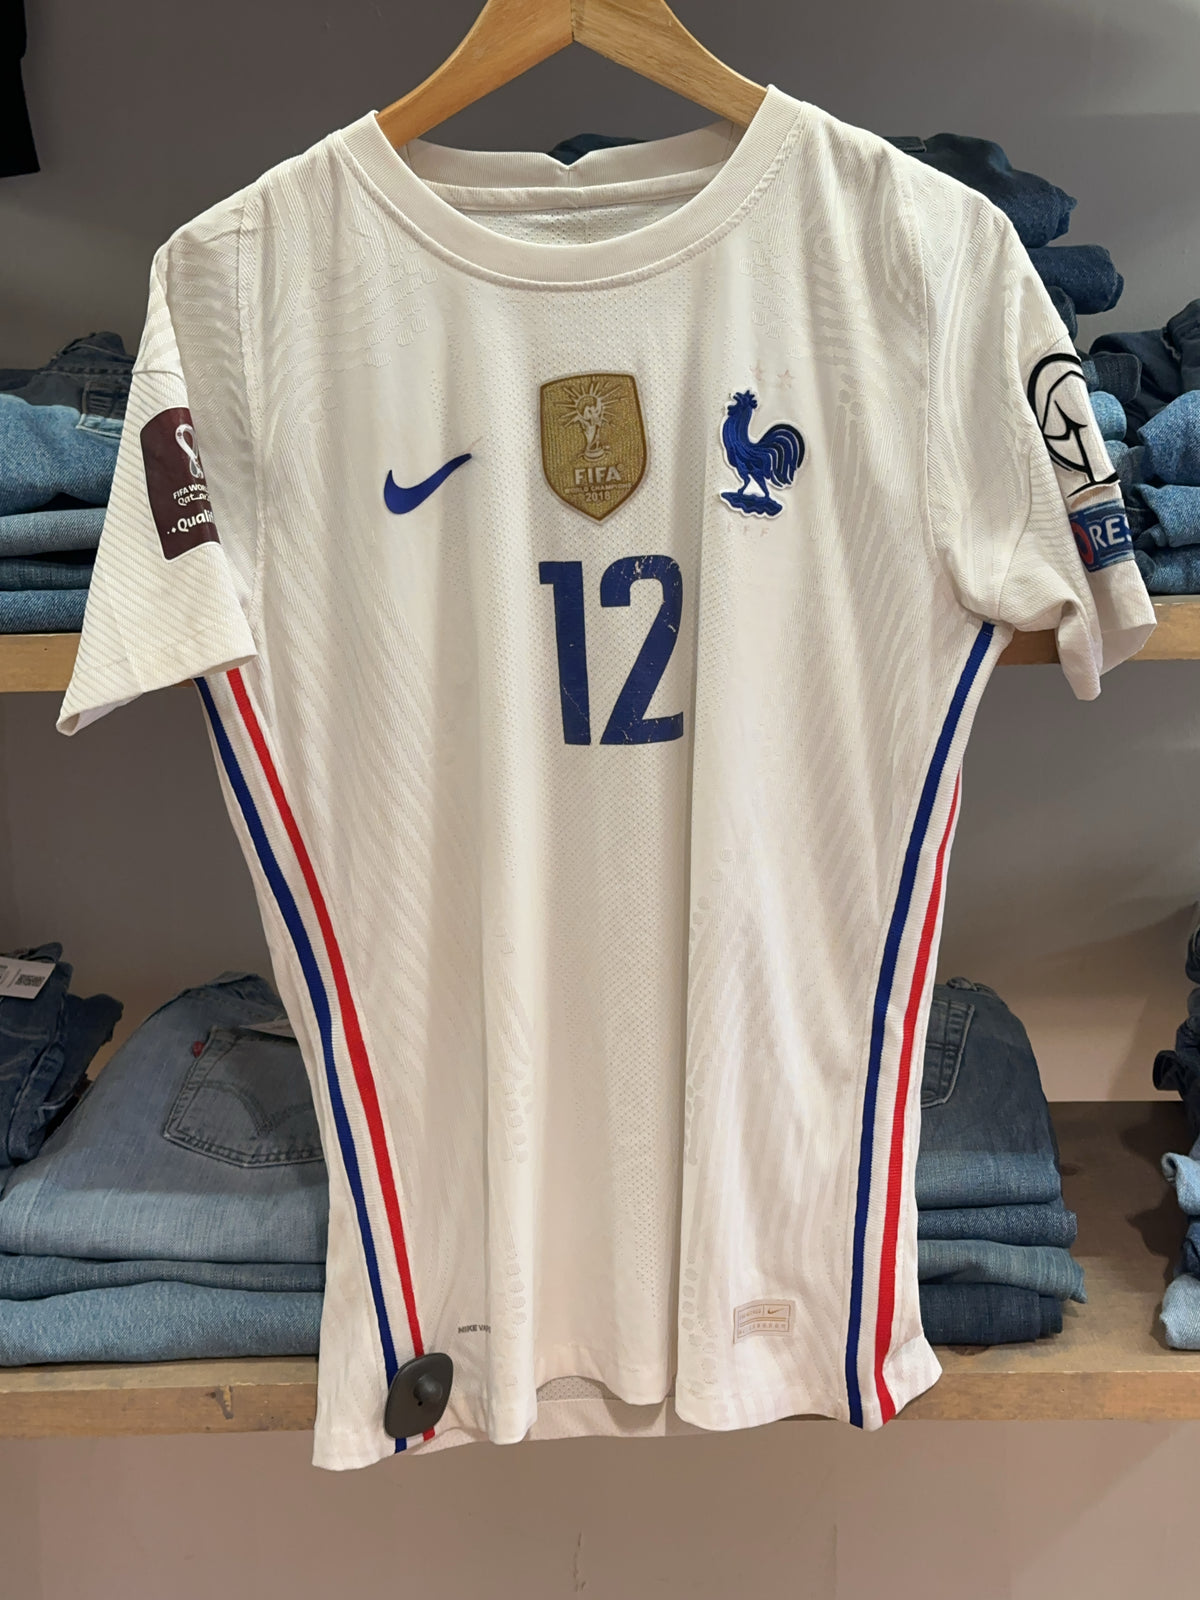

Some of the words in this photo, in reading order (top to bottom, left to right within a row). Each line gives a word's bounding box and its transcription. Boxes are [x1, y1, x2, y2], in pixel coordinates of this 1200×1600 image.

[574, 466, 622, 485] FIFA
[173, 486, 190, 500] FIFA
[585, 491, 611, 502] 2018
[538, 554, 684, 746] 12
[458, 1324, 478, 1334] NIKE
